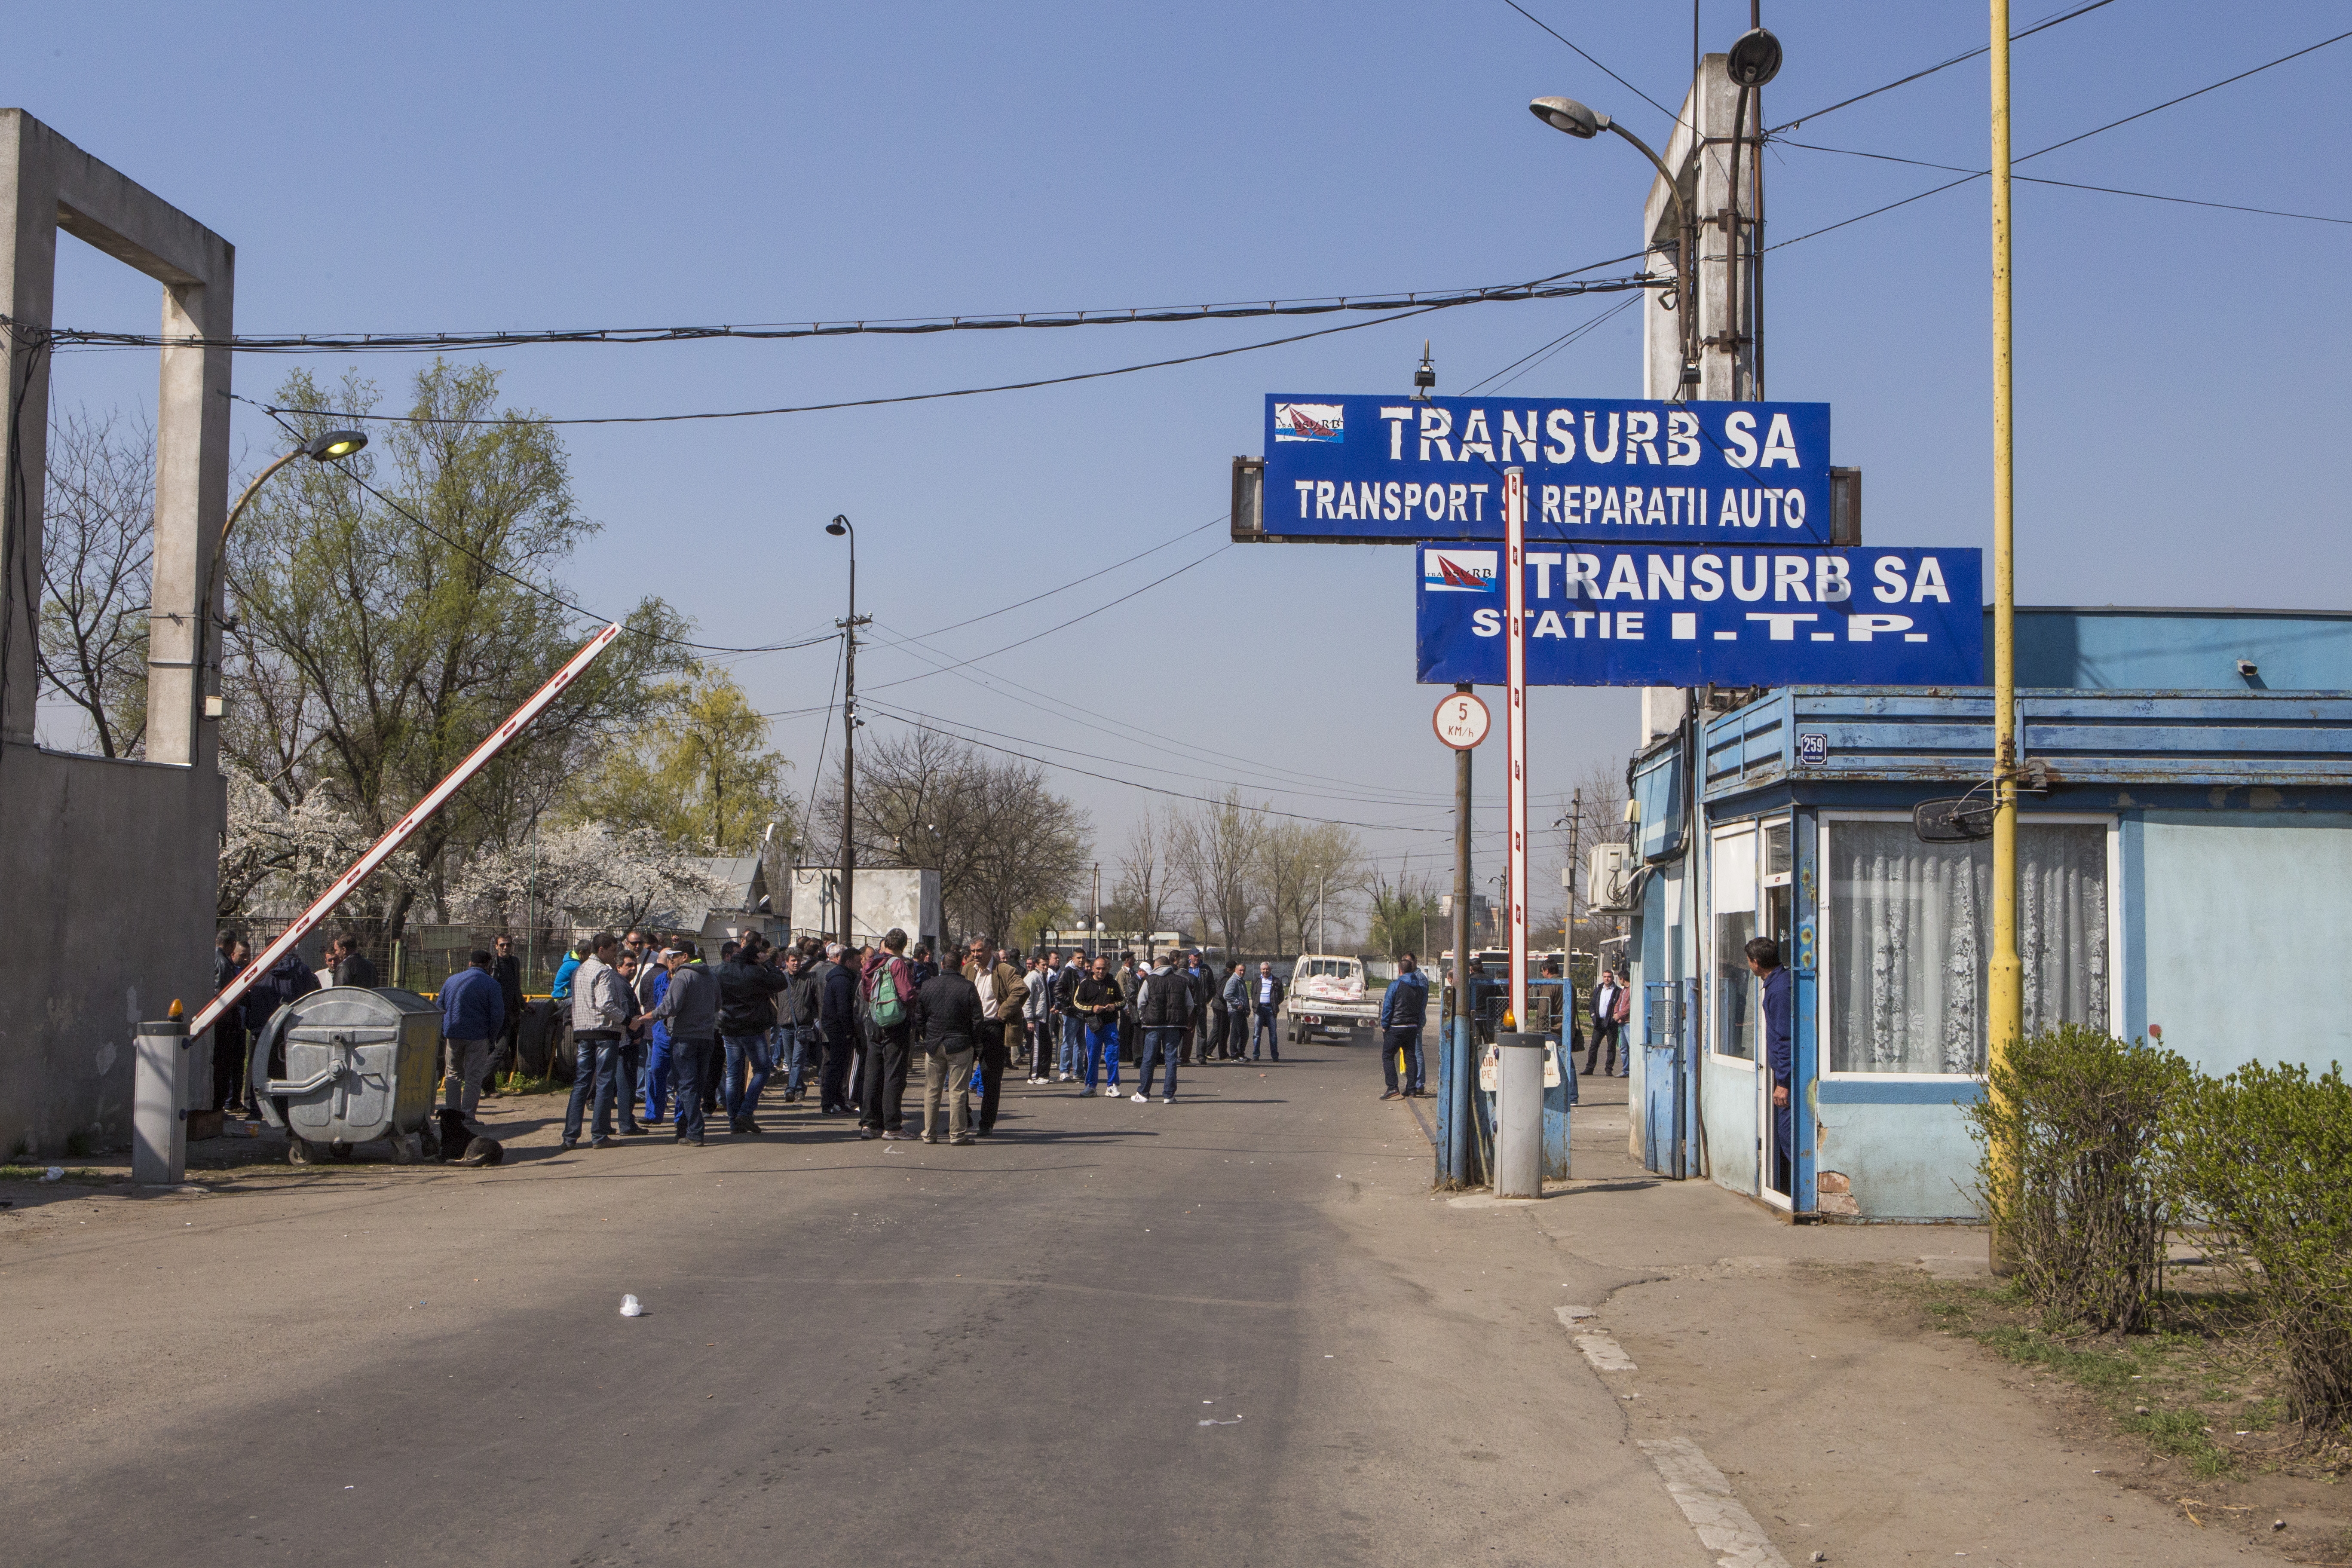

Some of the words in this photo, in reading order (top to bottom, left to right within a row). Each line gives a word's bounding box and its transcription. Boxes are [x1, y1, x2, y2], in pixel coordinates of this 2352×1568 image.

[1380, 407, 1701, 466] TRANSURB
[1724, 411, 1801, 469] SA
[1295, 480, 1488, 521] TRANSPORT
[1501, 484, 1528, 522] I
[1542, 485, 1707, 525] REPARATII
[1719, 488, 1806, 529] AUTO
[1427, 568, 1491, 578] TRANSURB
[1525, 553, 1851, 602] TRANSURB
[1873, 556, 1951, 603] SA
[1472, 609, 1644, 640] SATIE
[1459, 703, 1467, 720] 5
[1448, 726, 1474, 737] KM/h
[1804, 737, 1823, 753] 259
[1482, 1070, 1492, 1079] PE
